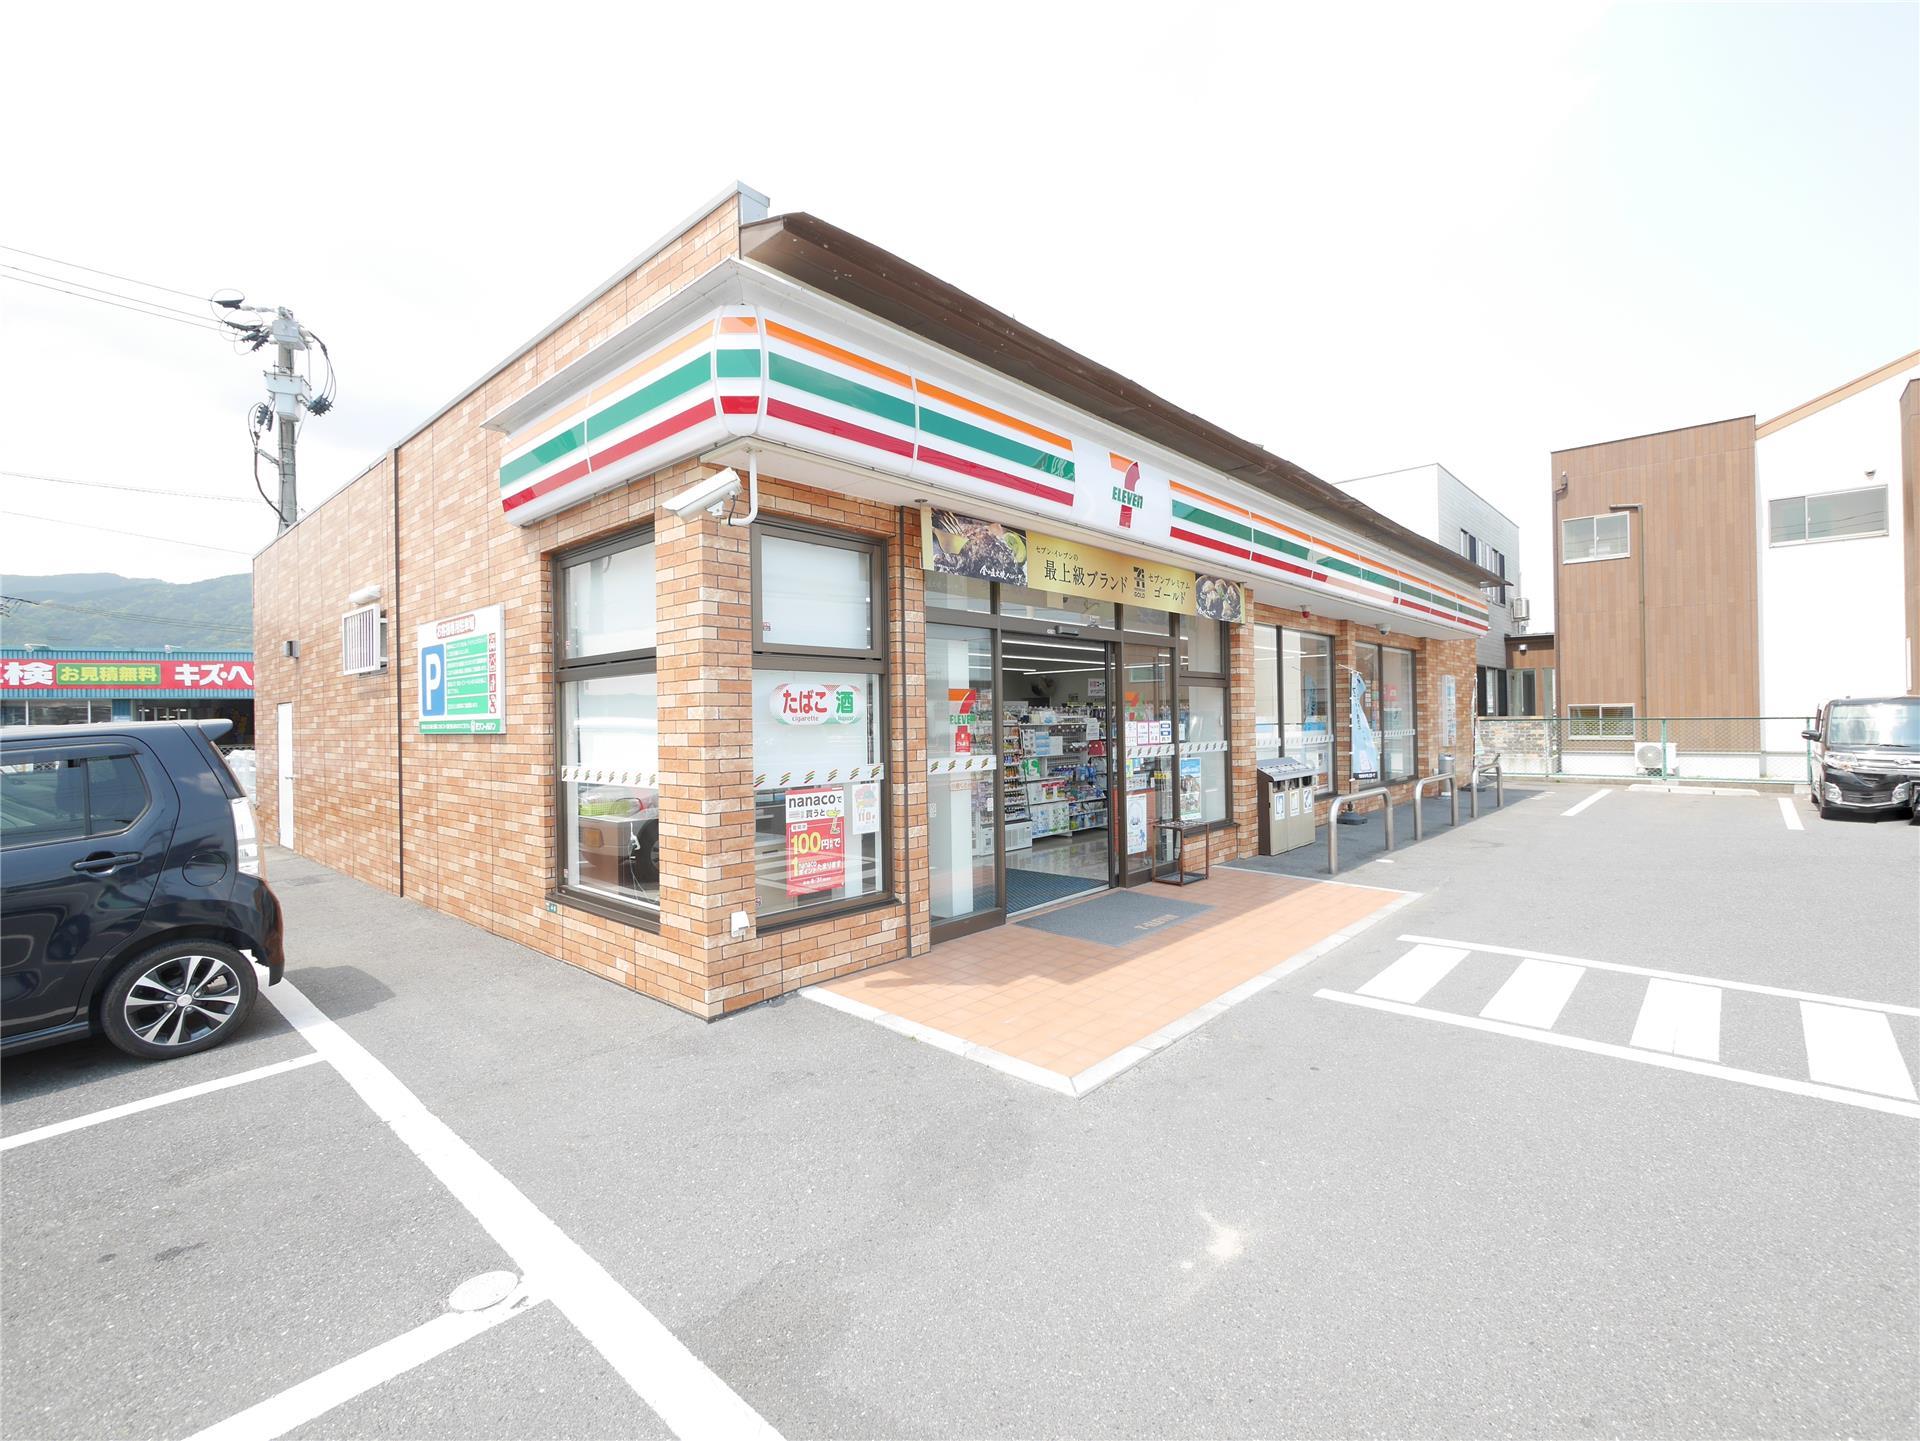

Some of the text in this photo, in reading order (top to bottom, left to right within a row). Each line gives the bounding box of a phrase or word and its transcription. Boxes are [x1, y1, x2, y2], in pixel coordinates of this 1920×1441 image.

[1044, 560, 1128, 593] 最上級ブランド
[1148, 573, 1191, 589] セブンプレミアム
[1154, 586, 1186, 604] ゴールド
[0, 661, 53, 686] 検
[60, 666, 158, 682] お見積無料
[425, 652, 441, 711] P
[783, 690, 827, 713] たばこ
[836, 691, 853, 713] 酒
